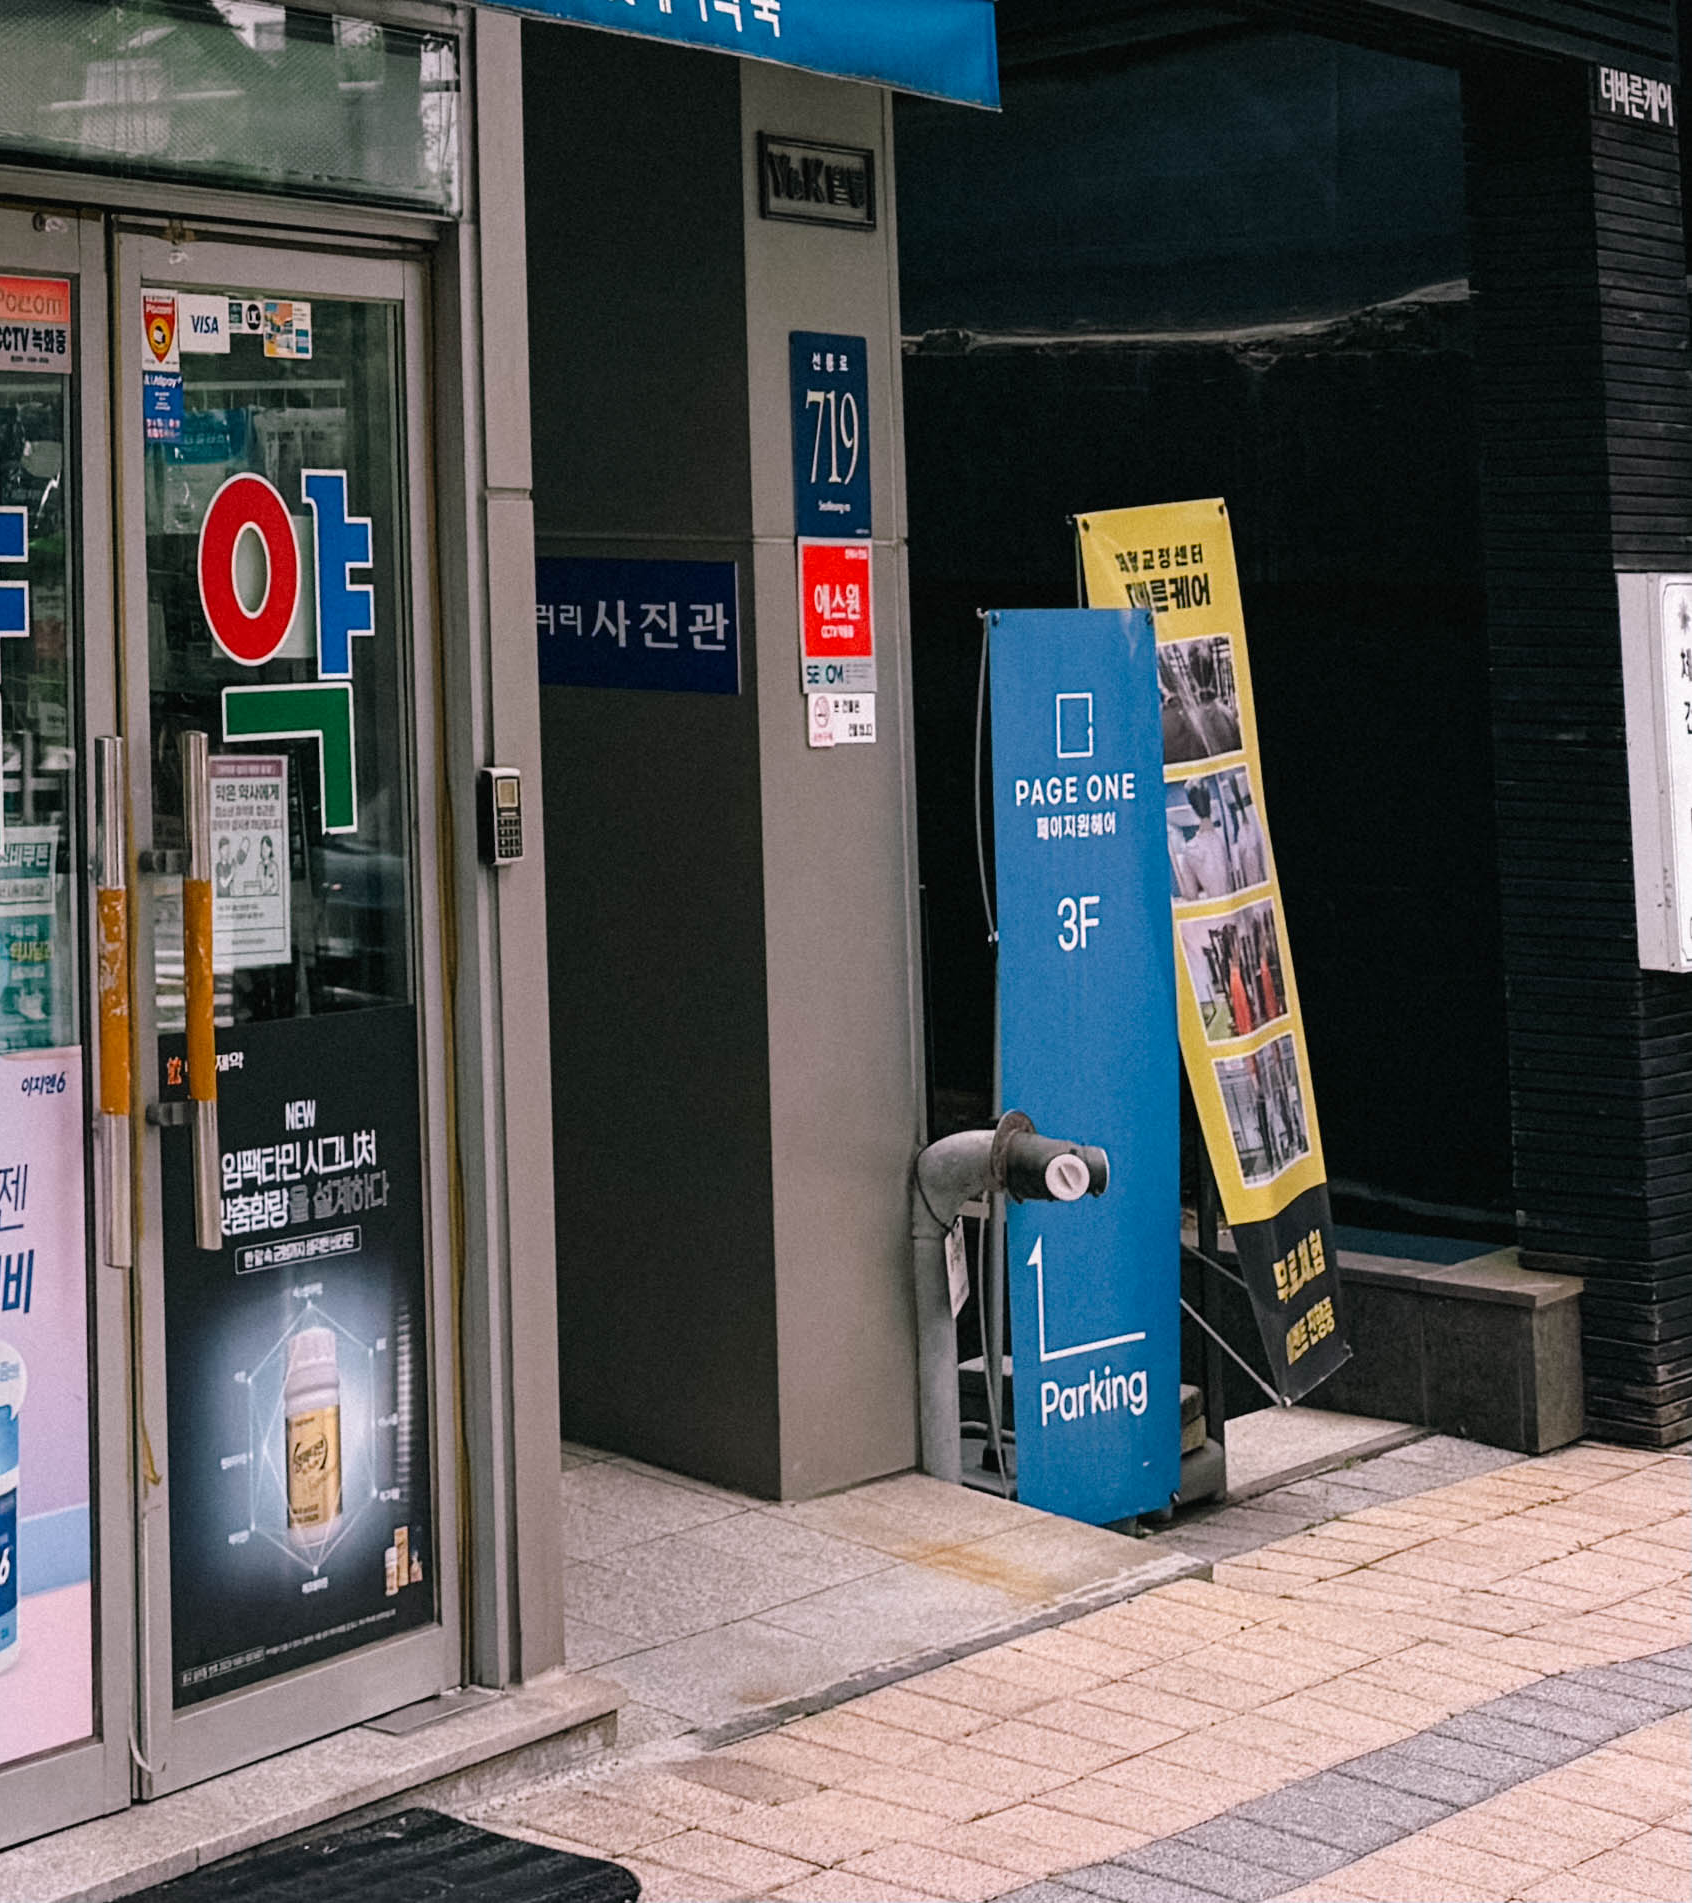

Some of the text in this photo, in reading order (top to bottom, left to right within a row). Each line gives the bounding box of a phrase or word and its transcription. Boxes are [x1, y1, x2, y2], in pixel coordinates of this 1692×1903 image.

[1599, 66, 1675, 128] 더바른케어
[32, 327, 66, 355] 녹화중
[191, 315, 220, 335] VISA
[805, 388, 860, 485] 719
[813, 583, 862, 621] 에스원
[591, 599, 730, 652] 사진관
[196, 467, 376, 836] 약
[1015, 772, 1137, 808] PAGE ONE
[1036, 811, 1117, 841] 페이지원헤어
[1057, 895, 1101, 952] 3F
[20, 1071, 67, 1097] 이지엔6
[285, 1099, 316, 1132] NEW
[221, 1129, 377, 1193] 임팩타민 시그니처
[1041, 1365, 1148, 1427] Parking
